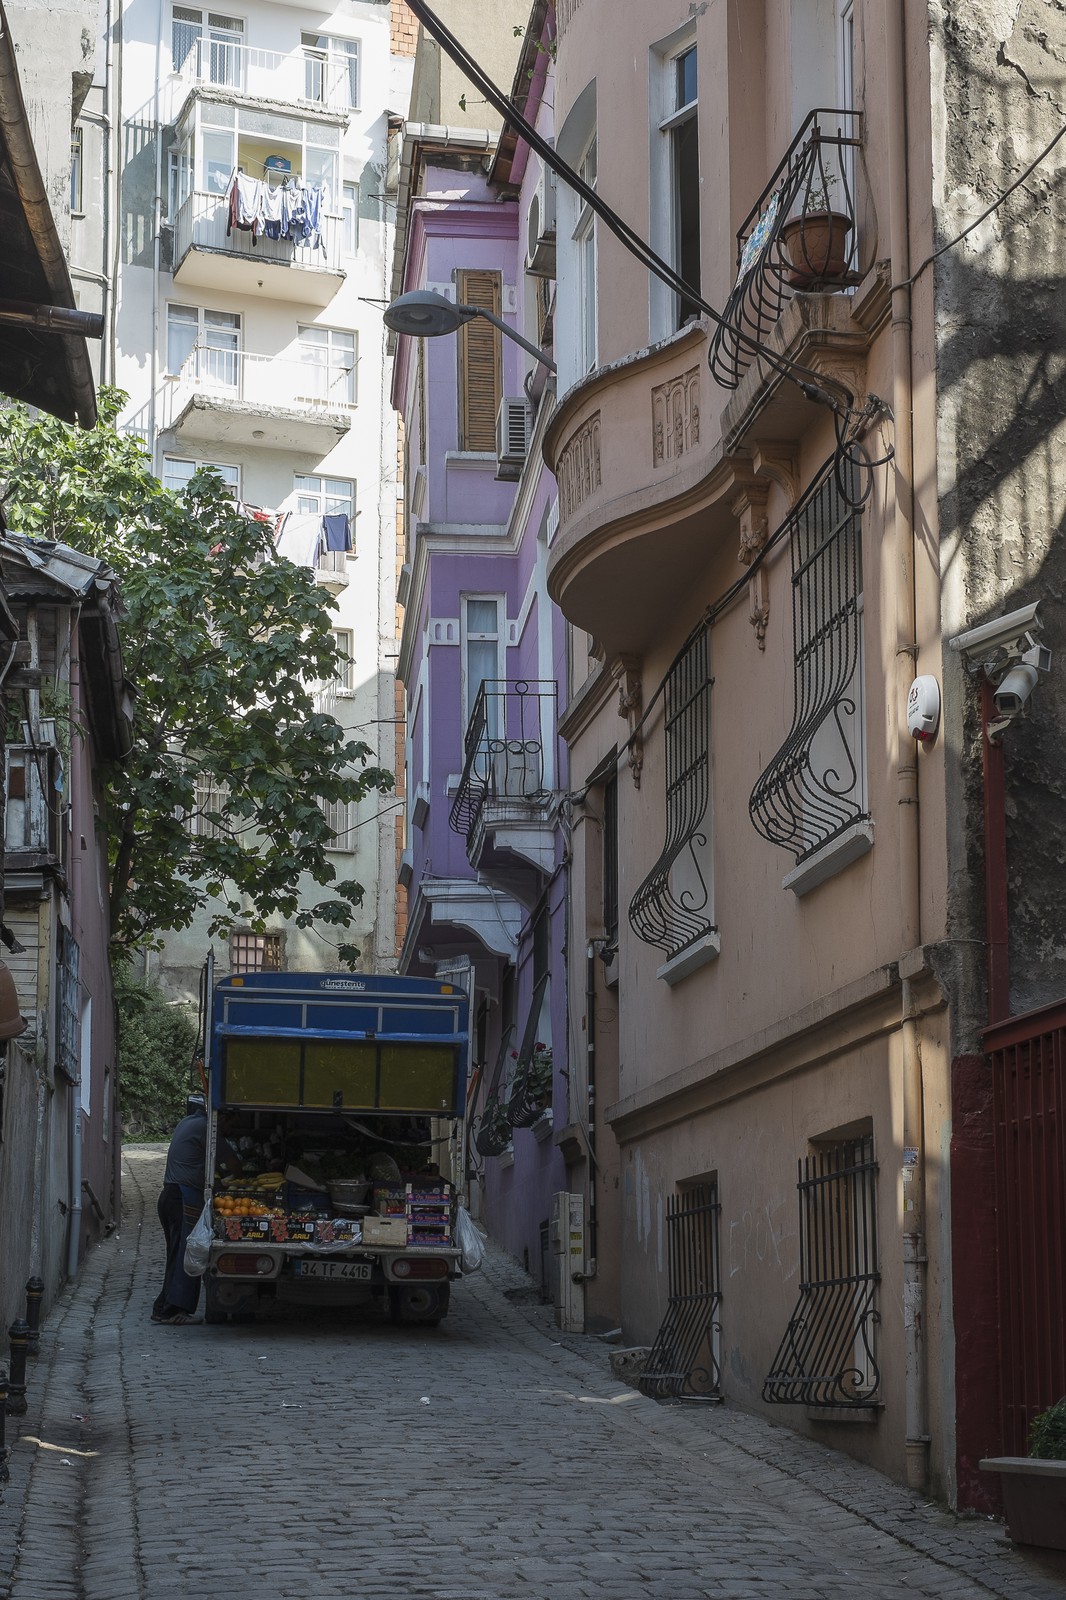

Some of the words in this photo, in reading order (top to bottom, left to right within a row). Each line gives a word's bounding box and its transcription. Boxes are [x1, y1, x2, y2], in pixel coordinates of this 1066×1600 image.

[302, 1262, 317, 1275] 34
[322, 1263, 336, 1276] TF
[341, 1264, 369, 1278] 4416
